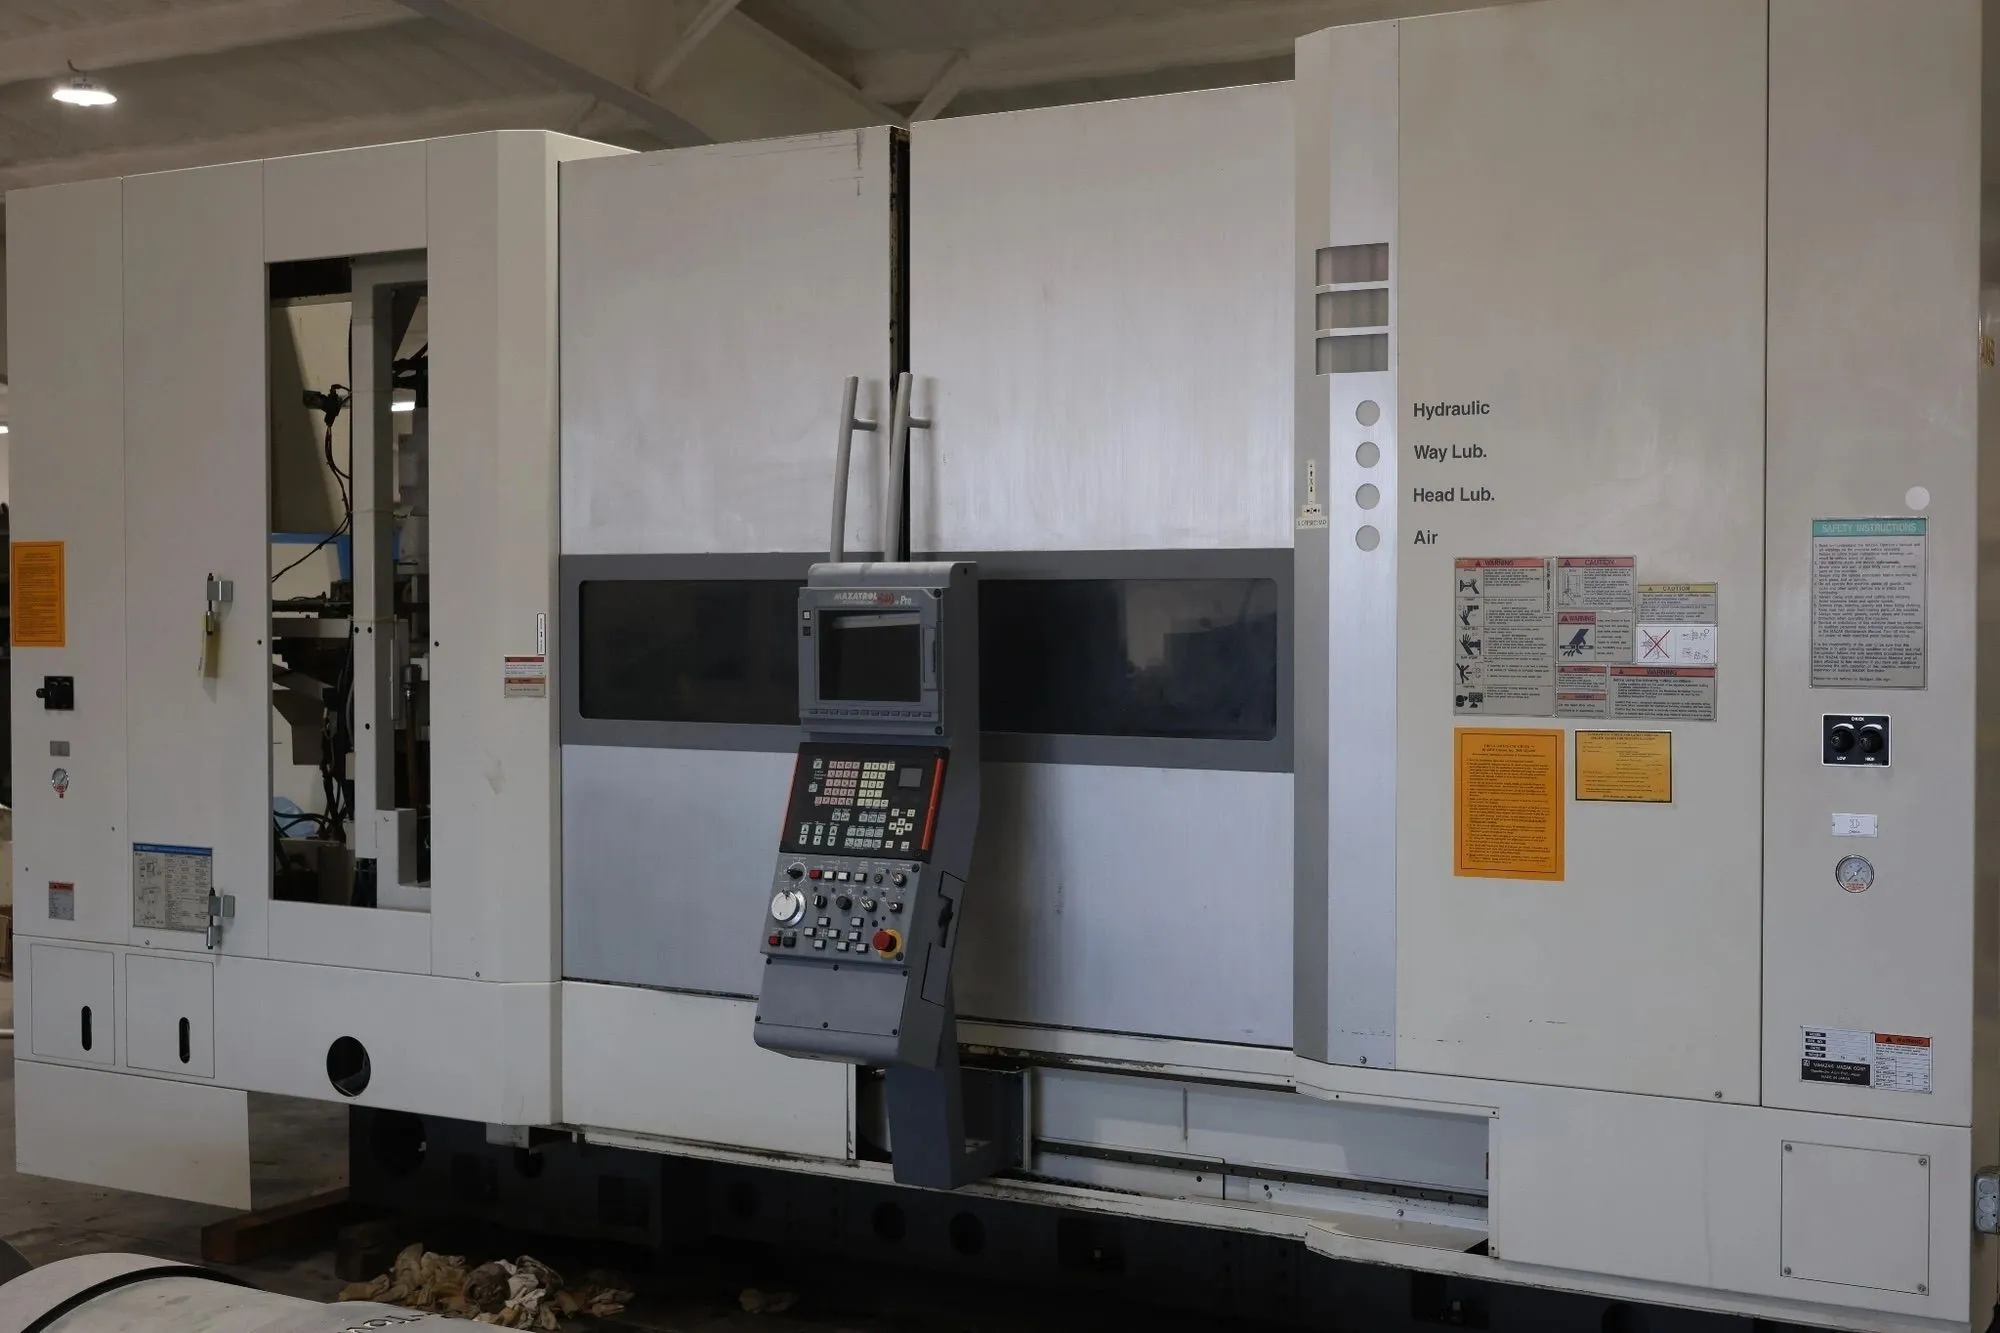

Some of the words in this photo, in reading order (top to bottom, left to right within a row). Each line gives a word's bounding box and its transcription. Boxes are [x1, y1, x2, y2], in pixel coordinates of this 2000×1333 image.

[1413, 401, 1490, 420] Hydraulic
[1414, 444, 1447, 462] Way
[1452, 444, 1487, 458] Lub.
[1413, 488, 1454, 502] Head
[1460, 487, 1495, 501] Lub.
[1822, 522, 1853, 533] SAFETY
[1856, 522, 1917, 533] INSTRUCTIONS
[1413, 530, 1438, 544] Air
[1484, 559, 1514, 567] WARNING
[834, 592, 877, 601] MAZATROL
